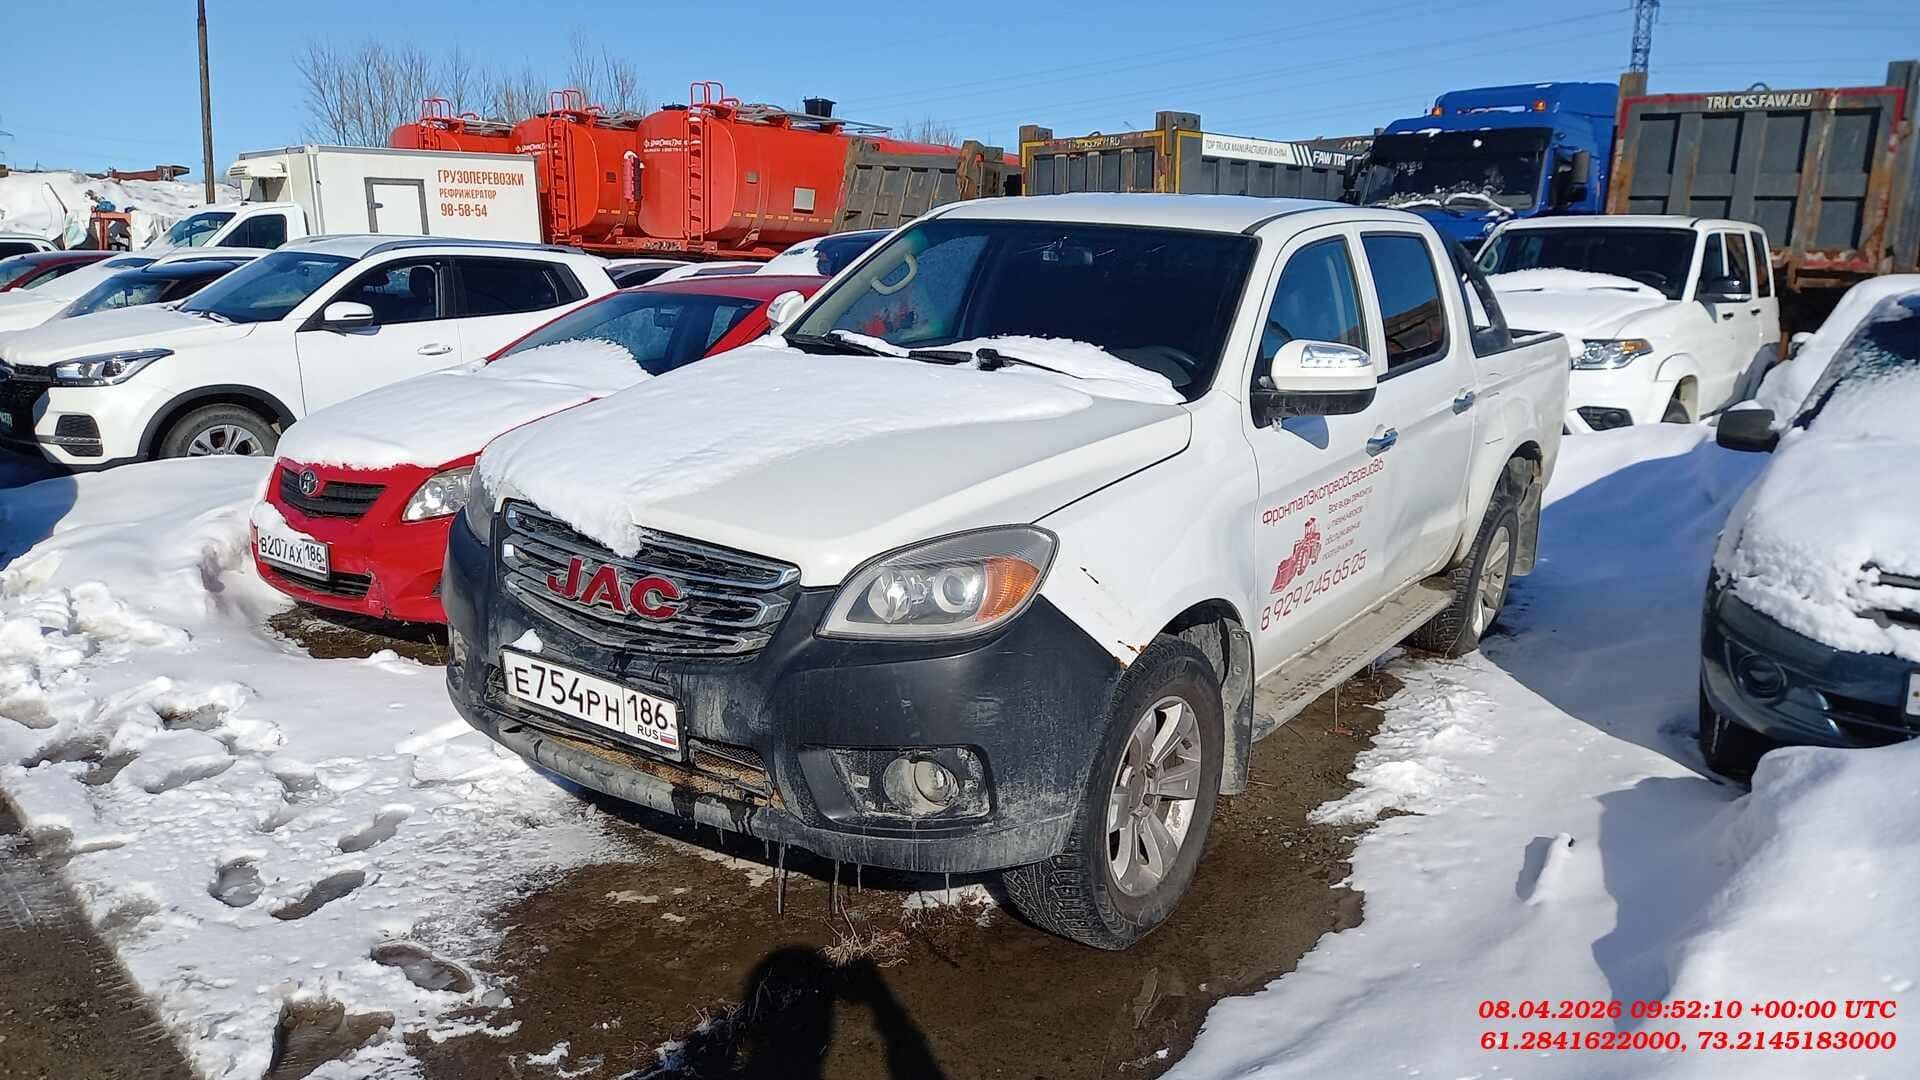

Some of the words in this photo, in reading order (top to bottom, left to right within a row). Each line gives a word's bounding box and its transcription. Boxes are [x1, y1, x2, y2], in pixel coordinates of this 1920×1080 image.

[1313, 151, 1332, 164] FAW
[437, 169, 524, 186] ГРУЗОПЕРЕВОЗКИ
[440, 187, 497, 200] РЕФРИЖЕРАТОР
[440, 202, 488, 217] 98-58-54
[304, 543, 322, 563] 186
[546, 554, 683, 620] JAC
[1260, 606, 1271, 631] 8
[1273, 586, 1303, 621] 929
[513, 664, 621, 726] Е754РН
[627, 693, 668, 730] 186
[636, 723, 659, 741] RUS
